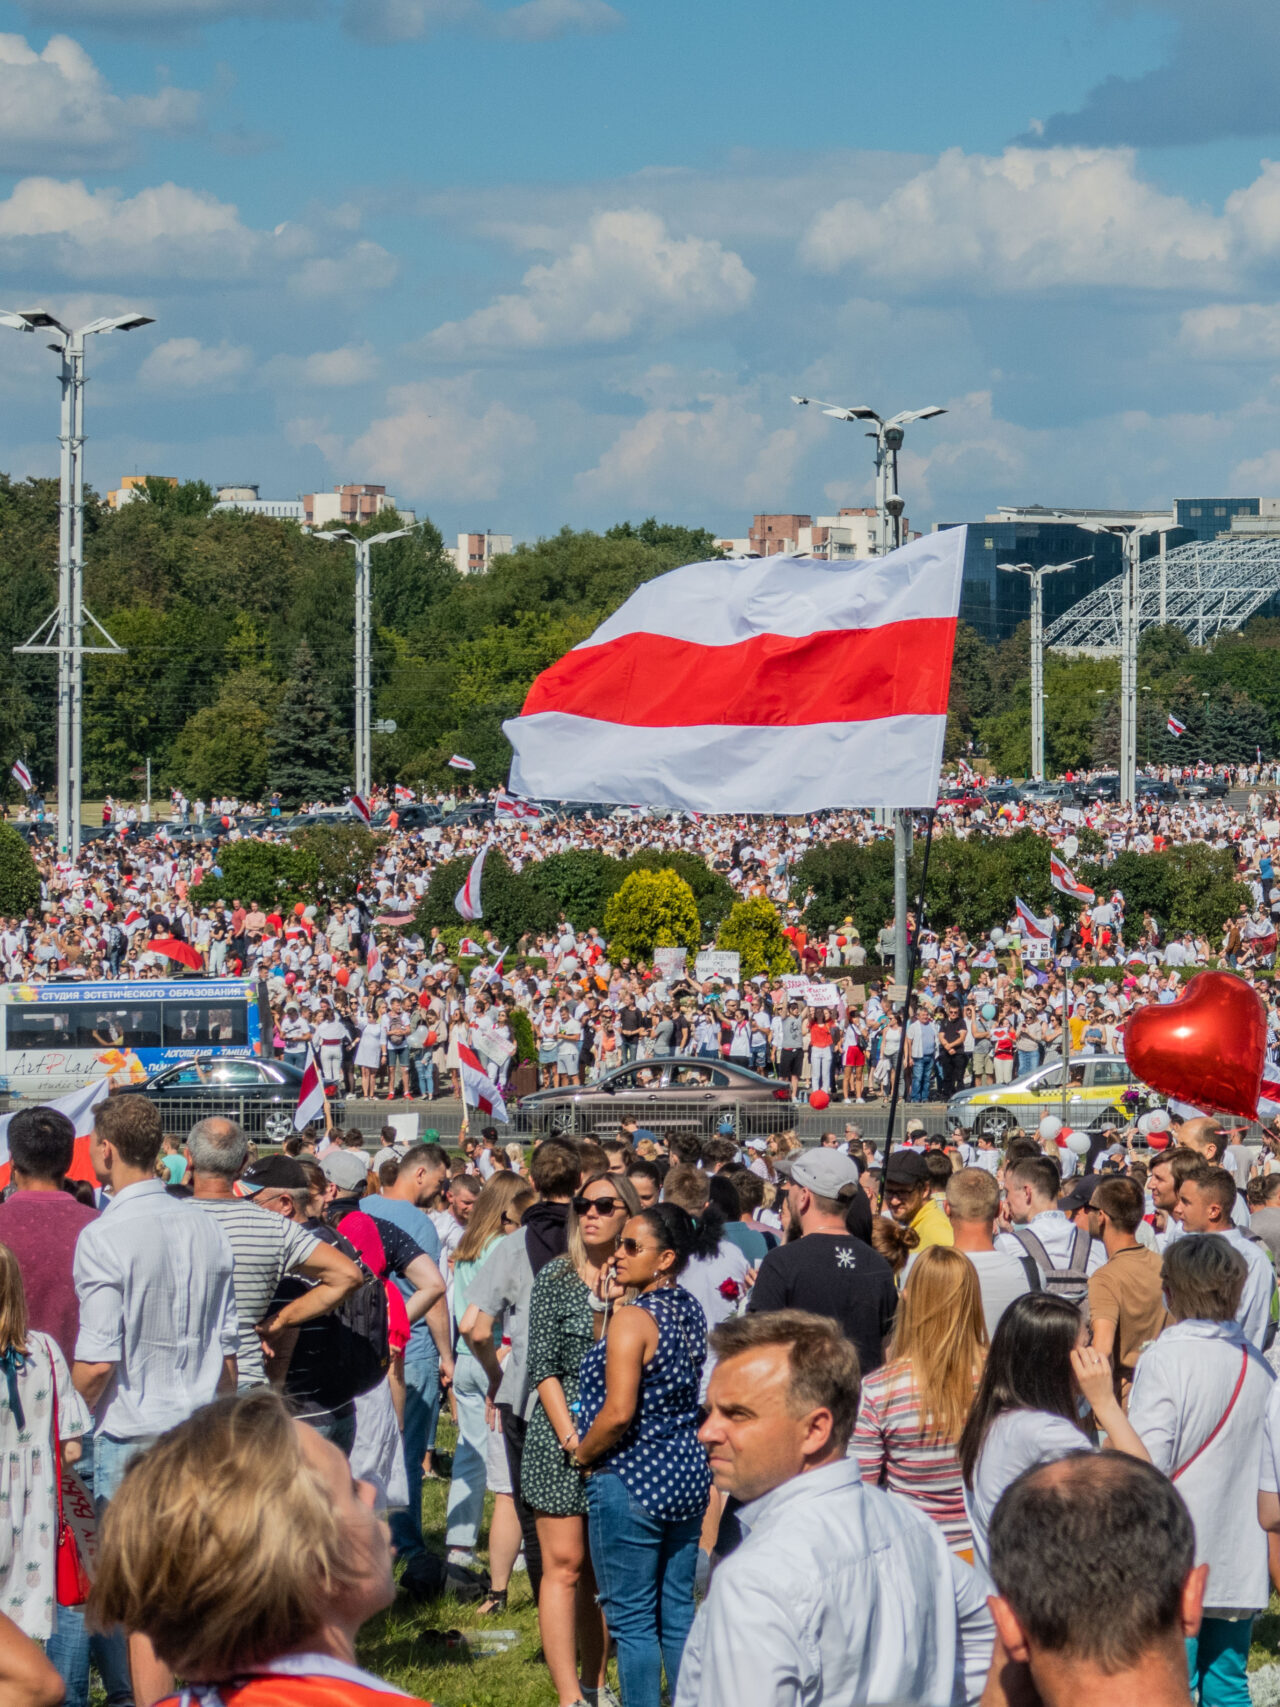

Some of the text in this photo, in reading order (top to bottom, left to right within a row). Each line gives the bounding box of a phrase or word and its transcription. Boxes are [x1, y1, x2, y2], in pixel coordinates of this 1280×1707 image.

[41, 988, 241, 1001] СТУДИЯ ЭСТЕТИЧЕСКОГО ОБРАЗОВАНИЯ
[164, 1048, 252, 1058] ЛОГОПЕДИЯ ТАНЦЫ
